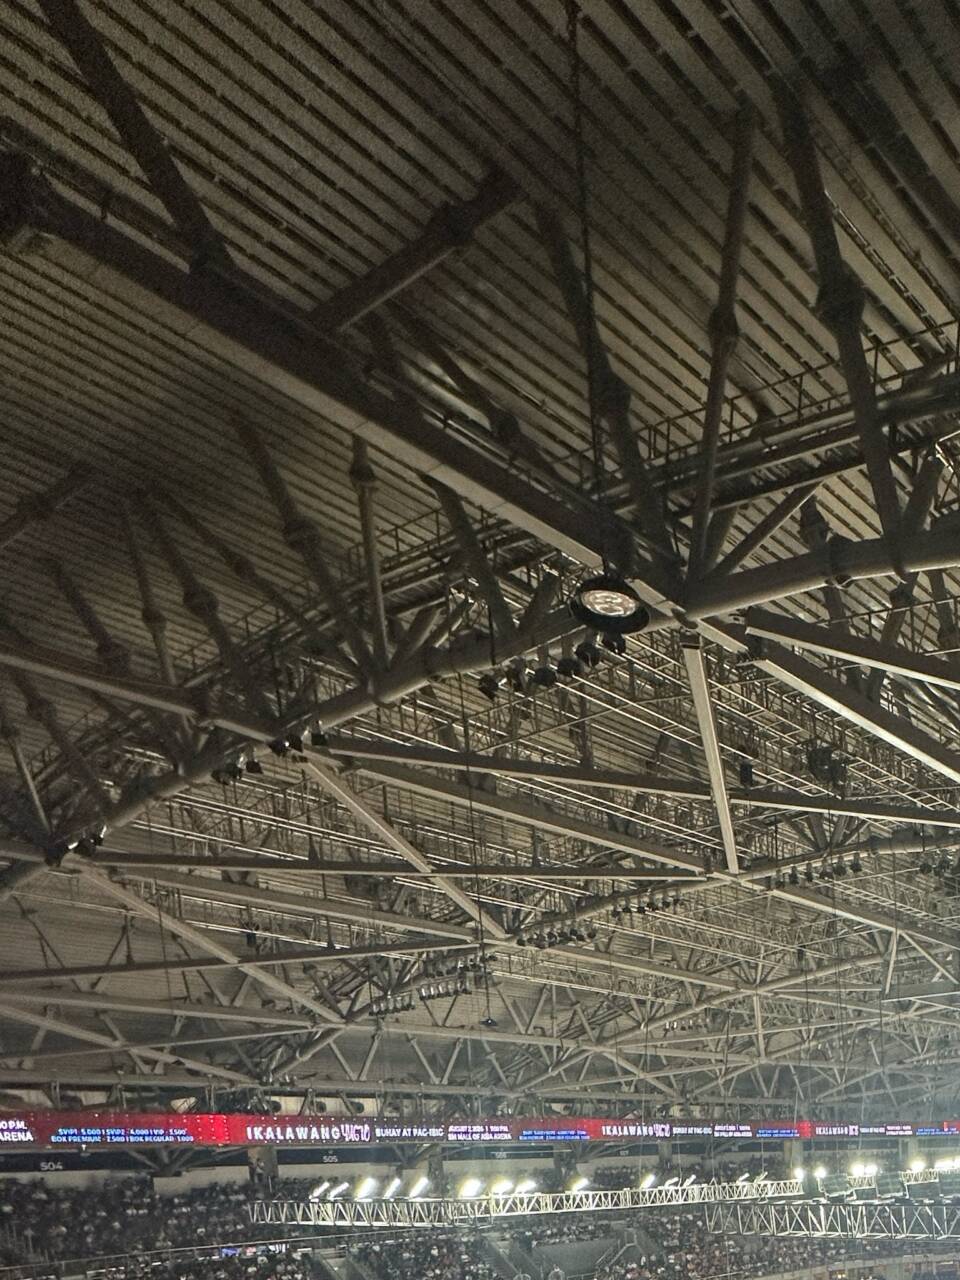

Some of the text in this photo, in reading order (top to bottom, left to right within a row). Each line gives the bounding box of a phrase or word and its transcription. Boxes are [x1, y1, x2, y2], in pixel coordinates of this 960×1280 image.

[246, 1126, 340, 1140] IKALAWANG
[375, 1128, 400, 1137] BUHAY
[402, 1128, 412, 1136] AT
[602, 1125, 653, 1136] IKALAWANG
[40, 1161, 63, 1170] 504
